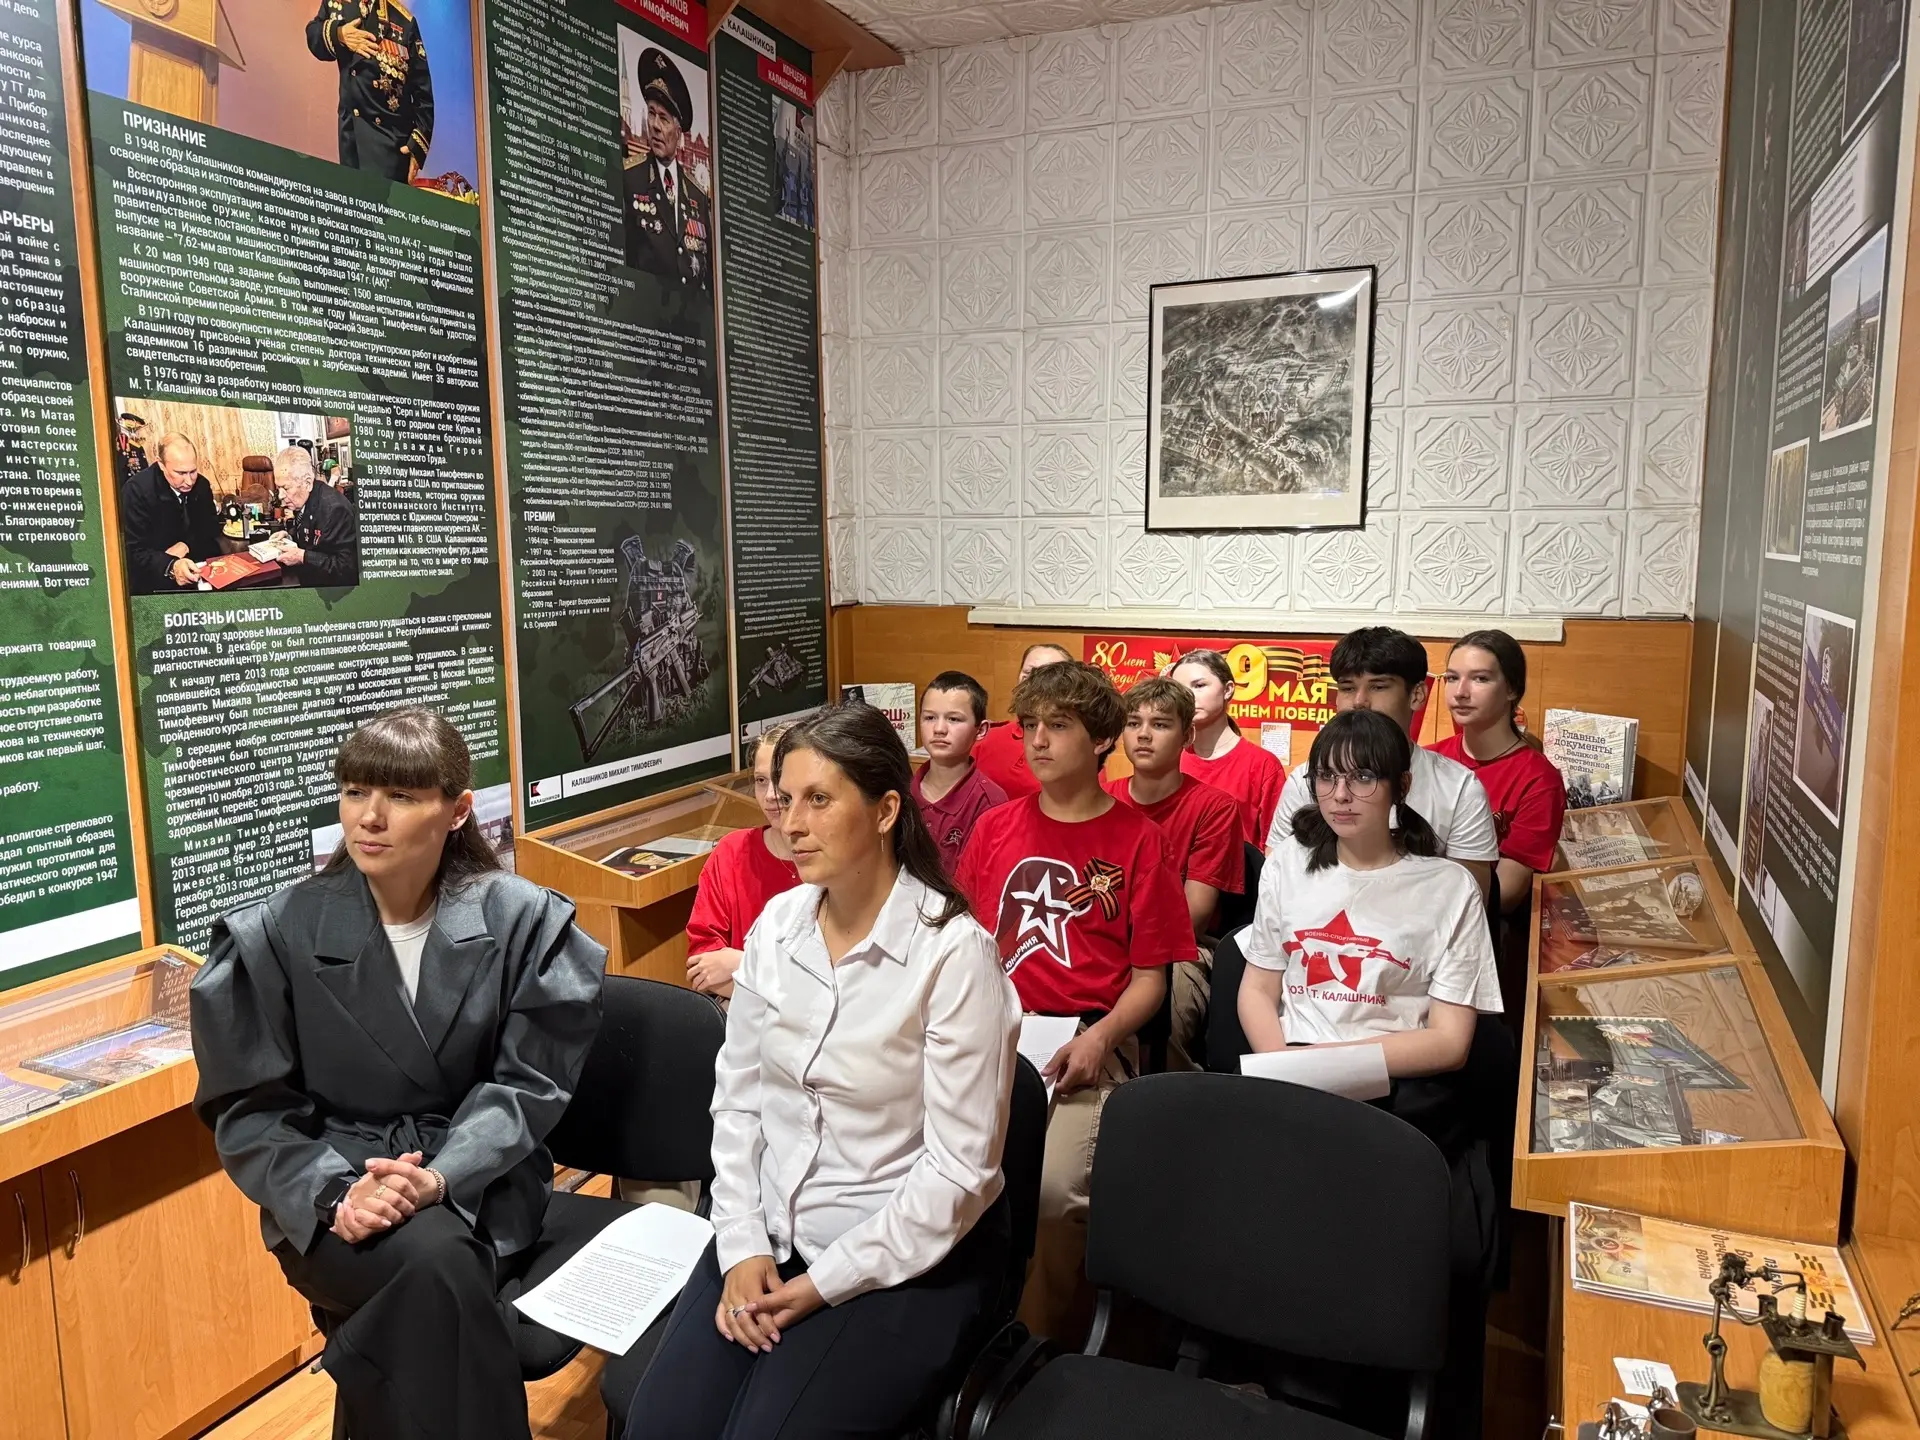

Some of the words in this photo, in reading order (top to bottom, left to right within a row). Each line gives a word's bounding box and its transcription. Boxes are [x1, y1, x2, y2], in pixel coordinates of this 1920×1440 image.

[13, 2, 39, 18] депо
[12, 34, 42, 52] курса
[727, 18, 775, 55] КАЛАШНИКОВ
[783, 63, 806, 86] КОНЦЕРН
[27, 87, 46, 100] для
[768, 70, 807, 101] КАЛАШНИКОВА
[8, 95, 47, 118] Прибор
[123, 110, 206, 148] ПРИЗНАНИЕ
[109, 145, 158, 166] освоение
[159, 158, 200, 178] образца
[208, 171, 269, 195] изготовление
[270, 187, 314, 207] войсковой
[315, 199, 343, 214] партии
[343, 207, 385, 225] автоматов.
[134, 135, 159, 152] 1948
[161, 145, 183, 161] году
[185, 149, 244, 175] Калашников
[245, 168, 311, 193] командируется
[324, 190, 348, 205] завод
[355, 198, 377, 213] город
[377, 202, 407, 221] Ижевск,
[408, 213, 420, 224] где
[420, 214, 439, 228] было
[439, 222, 471, 237] намечено
[16, 235, 48, 249] войне
[12, 263, 62, 282] Брянском
[15, 297, 65, 314] образца
[7, 313, 56, 327] наброски
[26, 346, 69, 360] оружию,
[1, 376, 72, 391] специалистов
[1, 390, 44, 405] образец
[44, 395, 73, 406] своей
[40, 408, 75, 421] Матая
[354, 425, 373, 436] 1980
[377, 428, 394, 440] году
[397, 431, 440, 441] установлен
[443, 432, 482, 444] бронзовый
[11, 439, 78, 452] мастерских
[5, 455, 79, 468] института,
[357, 487, 391, 499] Эдварда
[394, 488, 422, 500] Иззела,
[425, 492, 457, 501] историка
[460, 493, 485, 502] оружия
[4, 515, 75, 528] Благонравову
[360, 536, 395, 544] автомата
[397, 534, 414, 543] М16.
[425, 534, 442, 543] США
[444, 534, 487, 543] Калашникова
[27, 562, 89, 572] Калашников
[43, 577, 62, 587] Вот
[63, 577, 90, 586] текст
[164, 611, 224, 627] БОЛЕЗНЬ
[236, 607, 283, 622] СМЕРТЬ
[174, 631, 198, 644] 2012
[199, 632, 220, 643] году
[222, 628, 264, 641] здоровье
[265, 625, 302, 636] Михаила
[303, 621, 356, 633] Тимофеевича
[357, 619, 378, 629] стало
[379, 617, 420, 629] ухудшаться
[426, 615, 446, 623] связи
[451, 612, 491, 623] преклонным
[47, 639, 96, 651] товарища
[1091, 641, 1127, 667] 80
[1123, 658, 1147, 667] лет
[1225, 643, 1268, 701] 9
[1269, 680, 1328, 704] МАЯ
[14, 683, 100, 700] неблагоприятных
[1228, 703, 1270, 719] ДНЕМ
[16, 715, 72, 731] отсутствие
[73, 711, 103, 723] опыта
[1562, 729, 1606, 744] Главные
[1554, 738, 1613, 755] документы
[1566, 748, 1599, 761] Великой
[1554, 753, 1610, 770] Отечественной
[1569, 763, 1594, 774] войны
[530, 793, 560, 805] КАЛАШНИКОВ
[184, 833, 231, 851] Михаил
[236, 815, 308, 838] Тимофеевич
[170, 846, 229, 868] Калашников
[233, 839, 256, 854] умер
[274, 827, 308, 844] декабря
[171, 865, 195, 881] 2013
[197, 861, 218, 874] года
[232, 853, 254, 865] 95-м
[255, 847, 274, 859] году
[276, 840, 302, 854] жизни
[47, 876, 93, 894] конкурсе
[95, 867, 118, 882] 1947
[173, 872, 229, 893] Ижевске.
[235, 854, 293, 877] Похоронен
[1005, 935, 1039, 970] ЮНАРМИЯ
[1695, 1248, 1714, 1280] война
